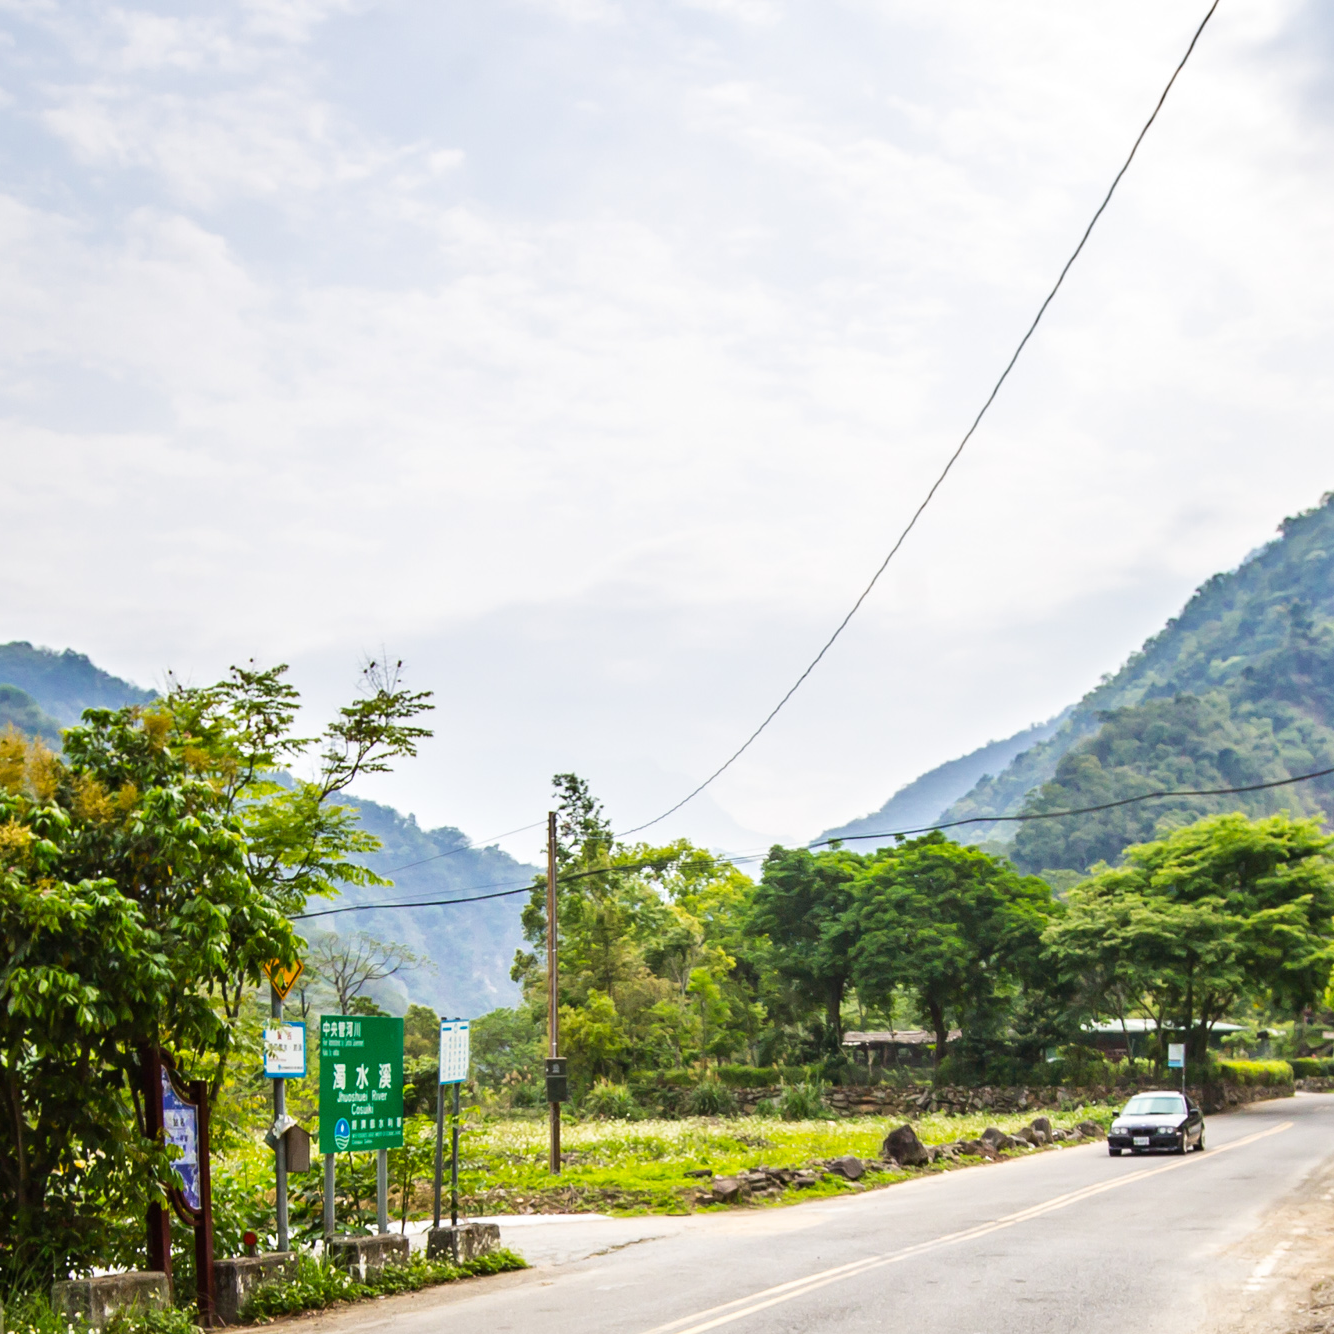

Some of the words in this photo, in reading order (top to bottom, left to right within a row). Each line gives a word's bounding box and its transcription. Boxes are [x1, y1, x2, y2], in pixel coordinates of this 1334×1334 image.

[333, 1063, 391, 1090] 濁水溪
[371, 1089, 387, 1101] River
